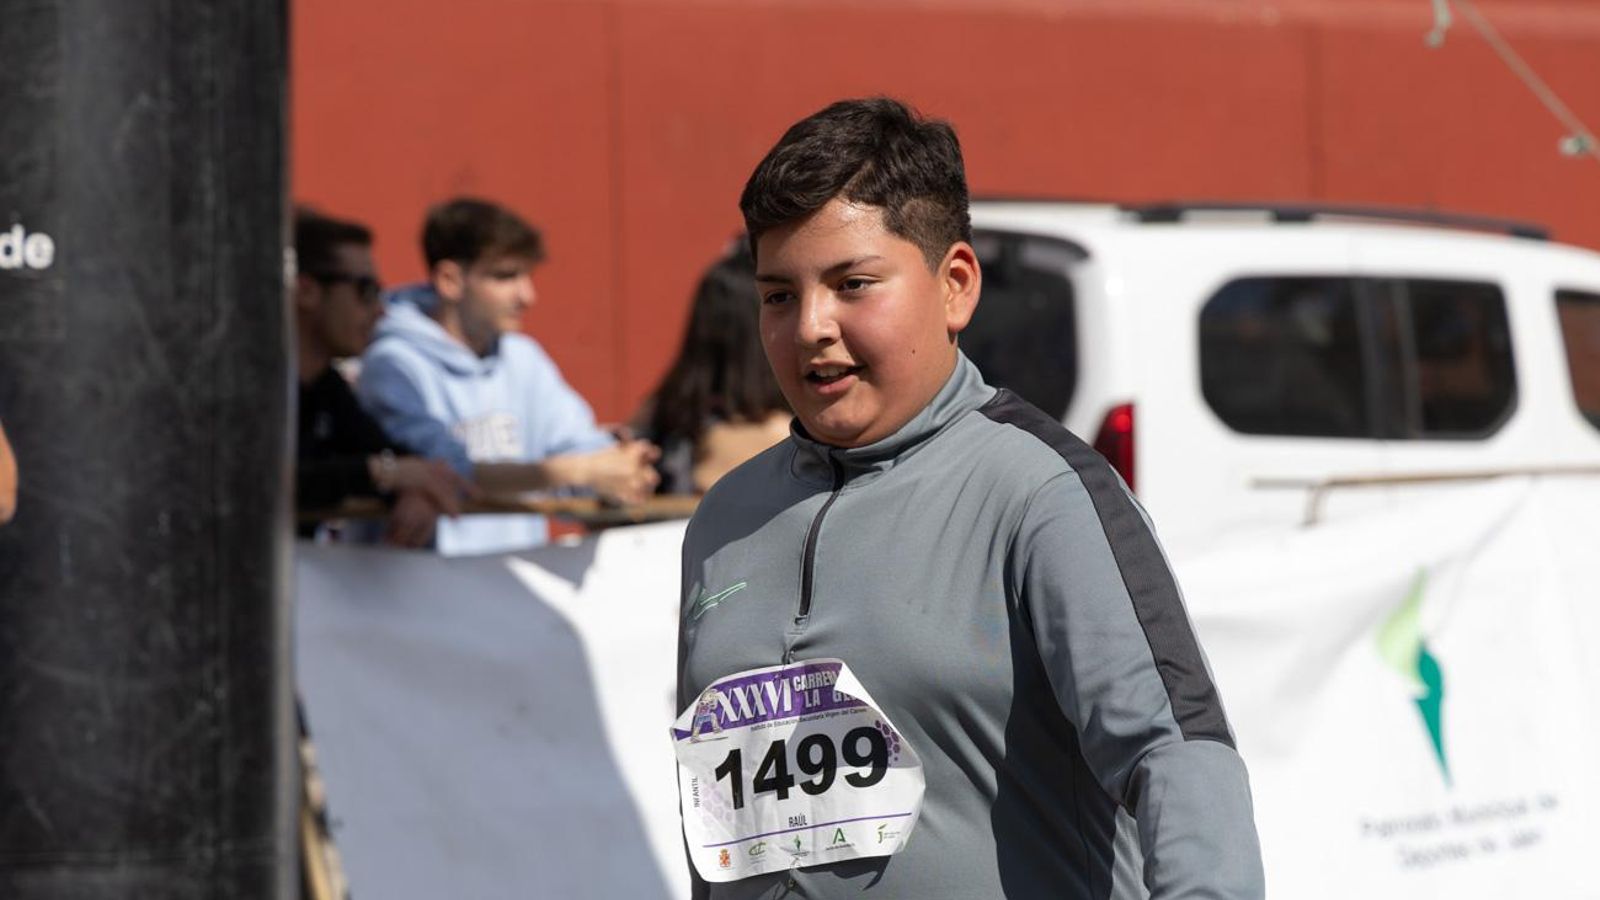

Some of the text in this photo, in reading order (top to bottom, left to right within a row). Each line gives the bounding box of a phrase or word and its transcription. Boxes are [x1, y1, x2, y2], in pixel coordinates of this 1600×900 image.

[0, 223, 55, 269] de
[718, 678, 792, 724] XXXVI
[805, 688, 821, 708] LA
[714, 726, 888, 810] 1499
[691, 776, 700, 808] INFANTIL
[788, 813, 807, 828] RAÚL
